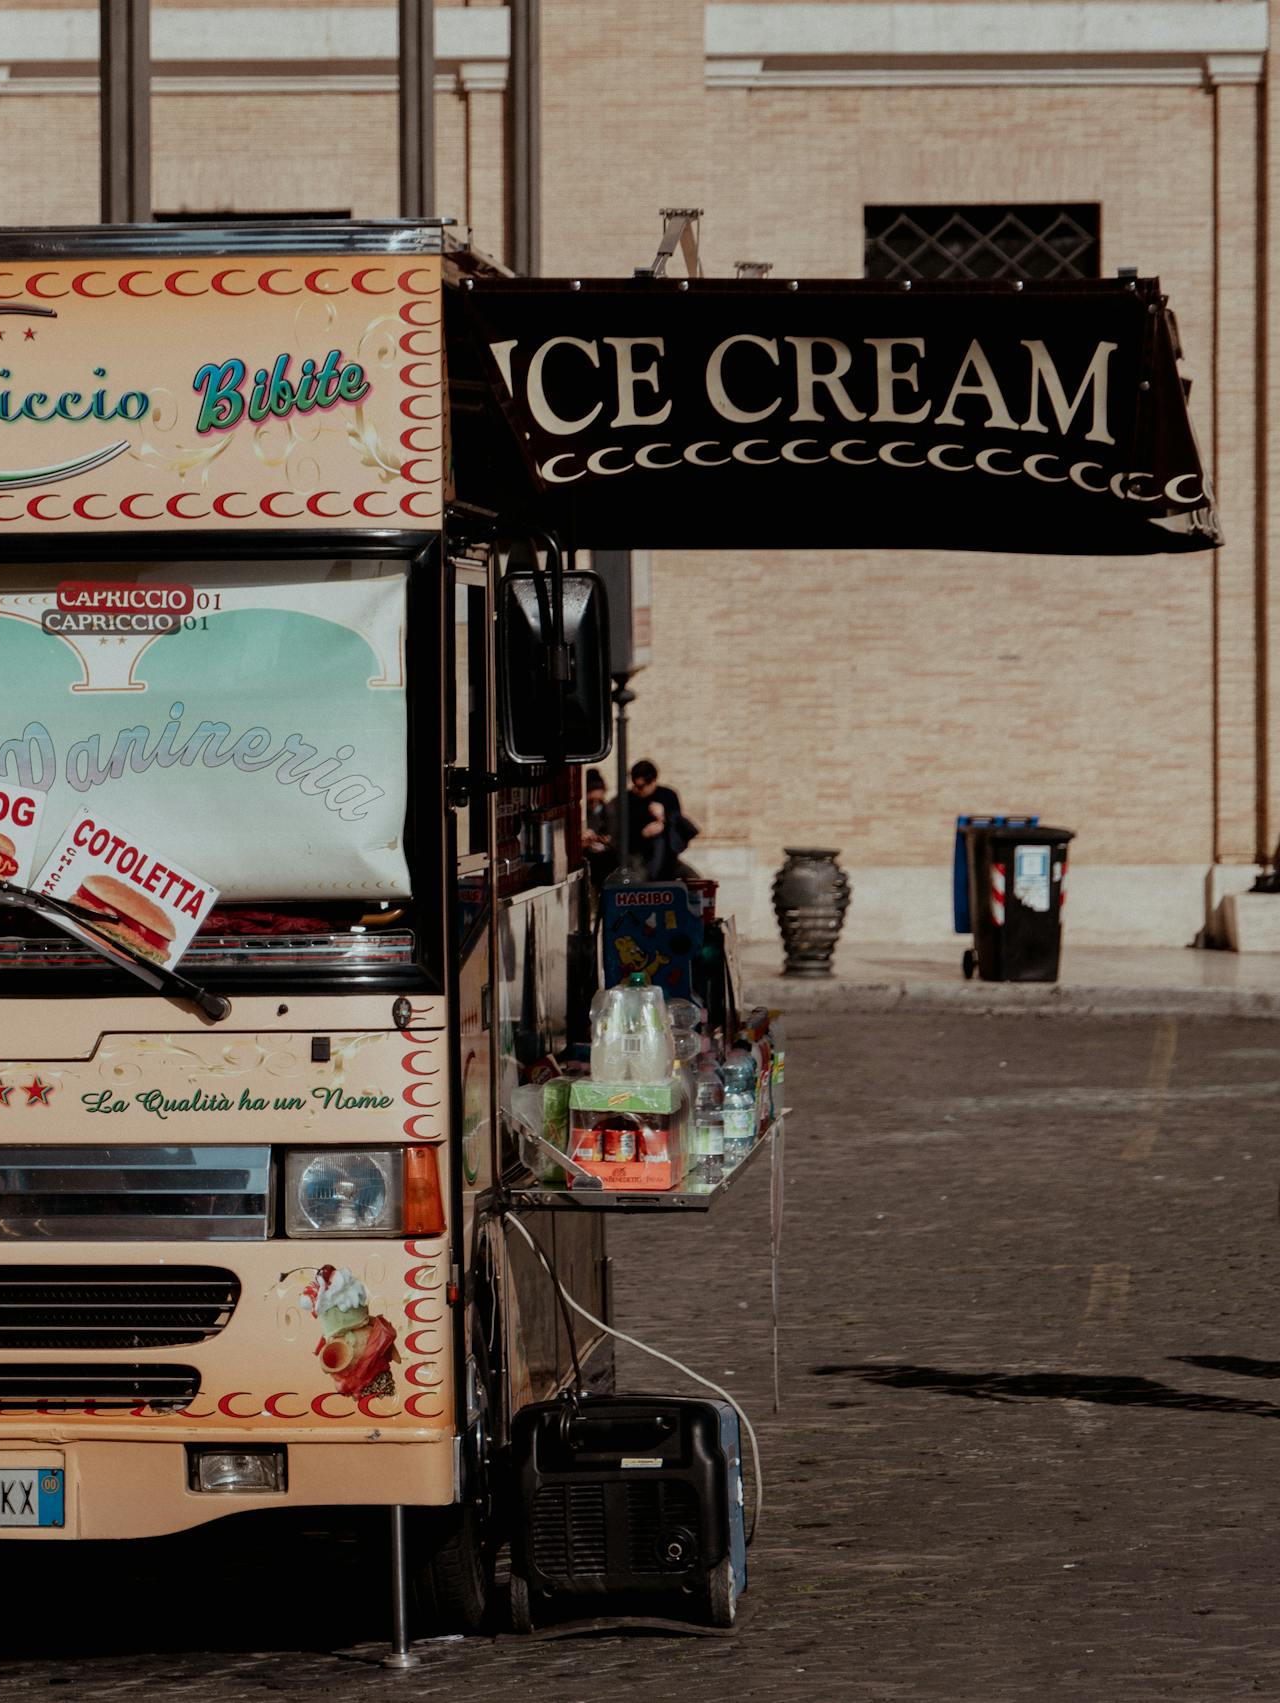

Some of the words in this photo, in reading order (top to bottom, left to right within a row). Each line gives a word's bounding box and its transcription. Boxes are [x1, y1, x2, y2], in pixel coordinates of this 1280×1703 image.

[193, 349, 371, 433] Bibite
[706, 334, 1118, 445] CREAM
[60, 589, 187, 610] CAPRICCIO
[196, 593, 222, 611] 01
[73, 818, 207, 920] COTOLETTA
[616, 891, 674, 907] HARIBO
[81, 1088, 130, 1114] La
[135, 1088, 235, 1120] Qualità
[237, 1087, 270, 1112] ha
[272, 1096, 308, 1111] un
[311, 1087, 396, 1110] Nome
